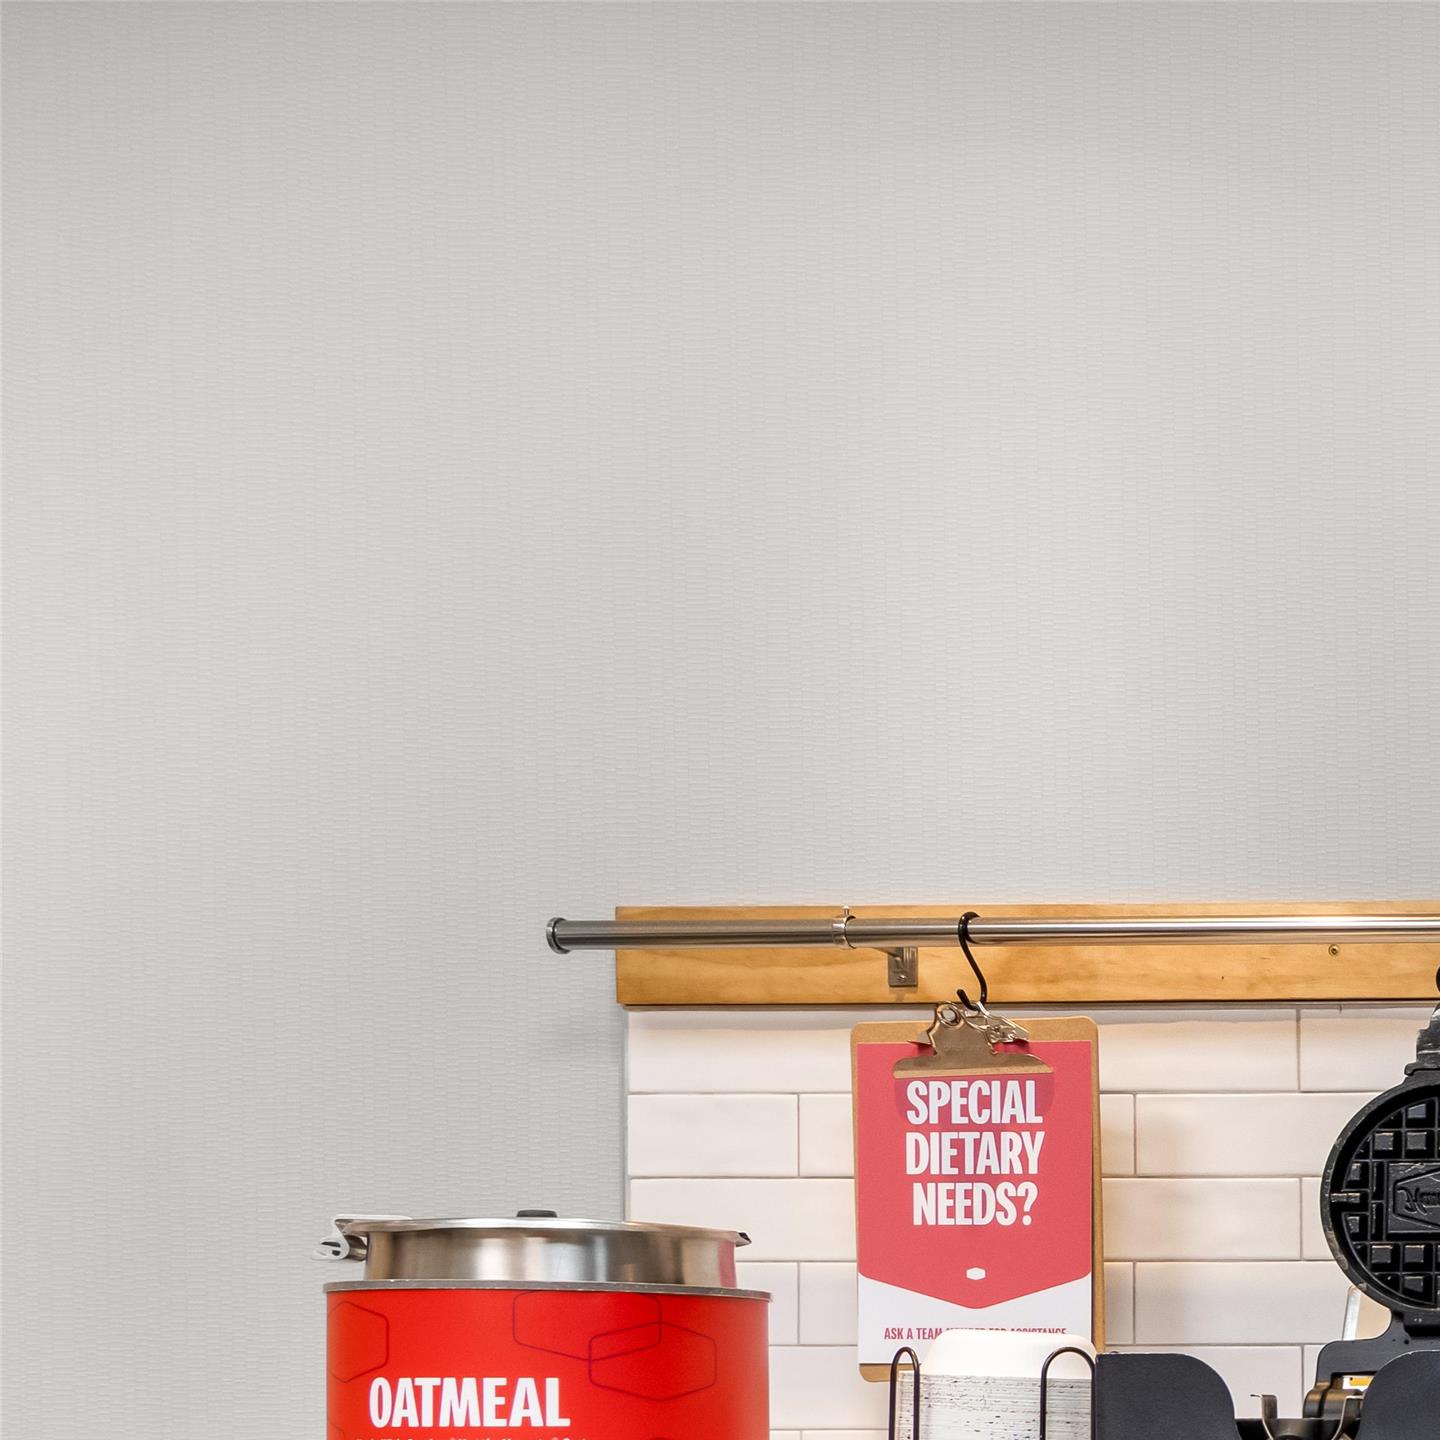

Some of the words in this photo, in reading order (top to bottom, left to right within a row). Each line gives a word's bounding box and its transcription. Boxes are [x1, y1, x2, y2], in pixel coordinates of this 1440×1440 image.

[906, 1080, 1043, 1125] SPECIAL
[906, 1131, 1046, 1175] DIETARY
[913, 1181, 1038, 1226] NEEDS?
[884, 1328, 904, 1340] ASK
[906, 1328, 914, 1340] A
[370, 1377, 570, 1428] OATMEAL
